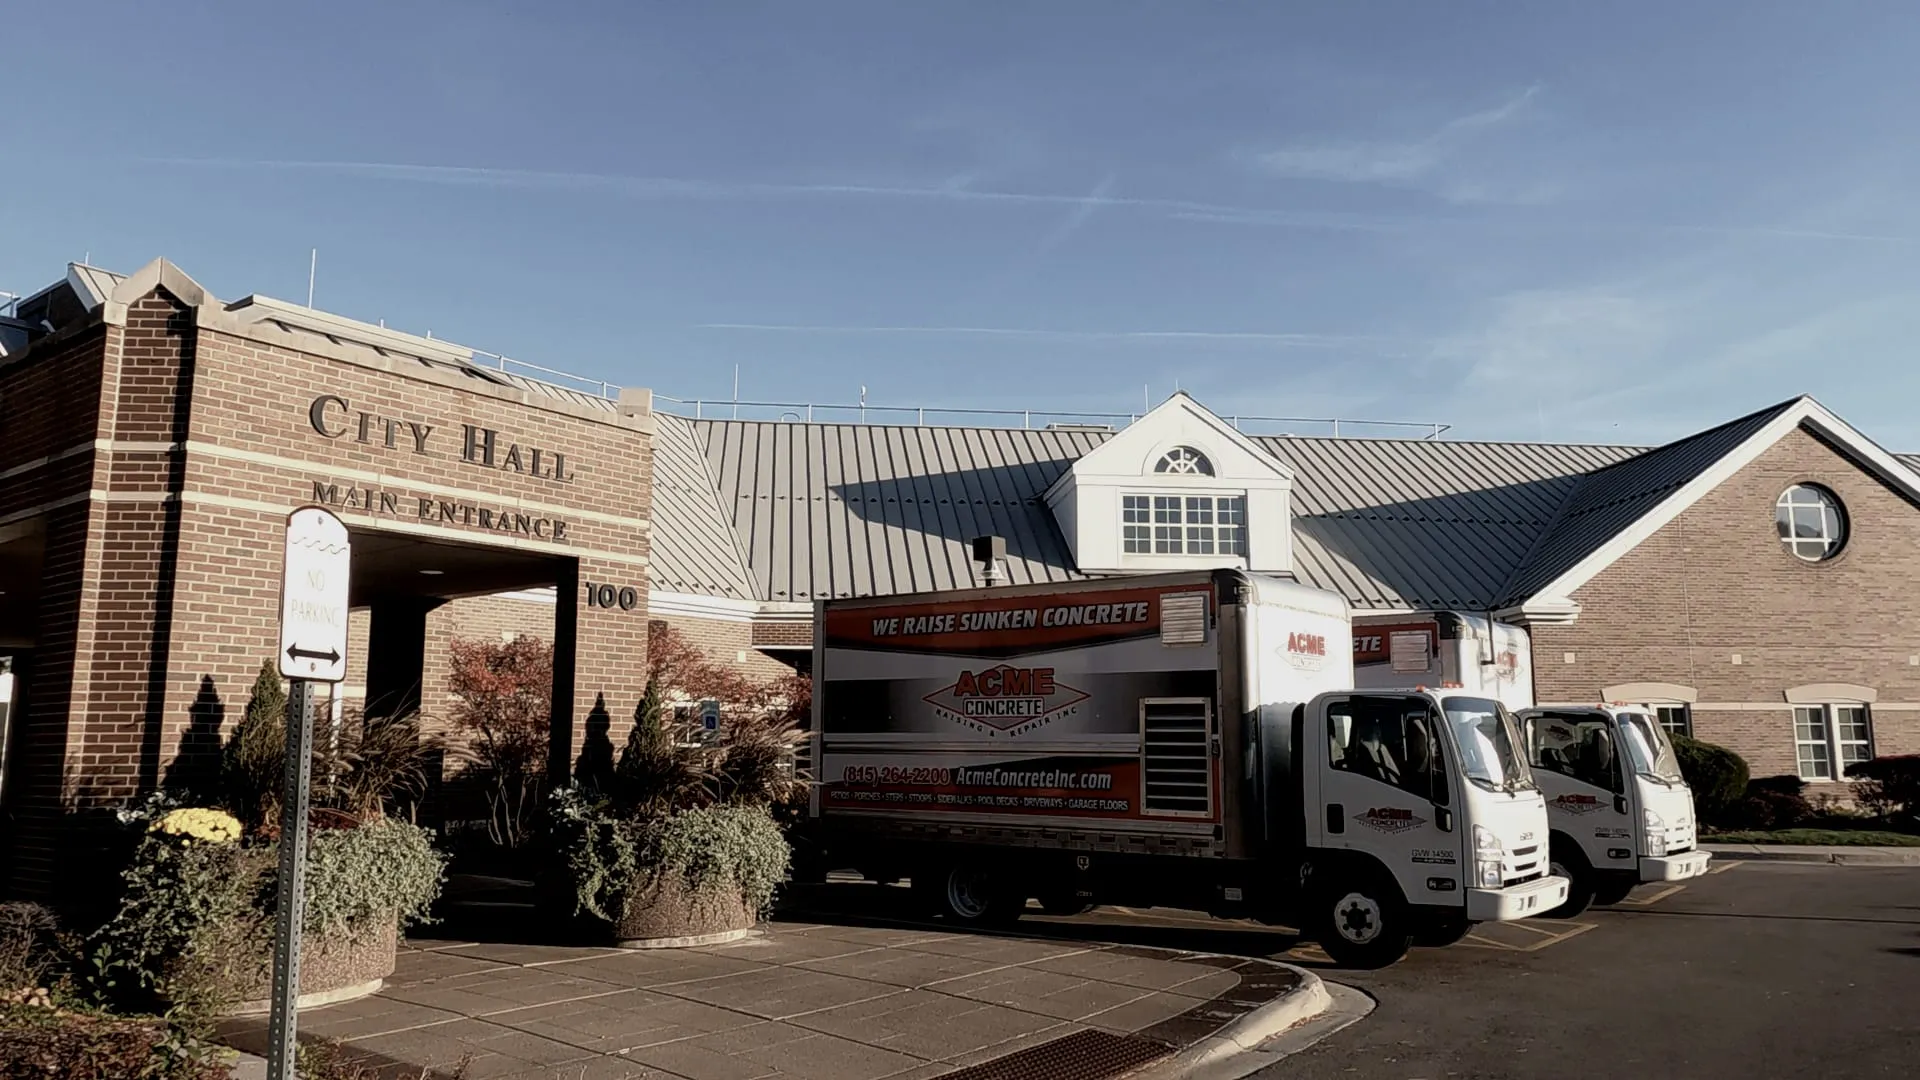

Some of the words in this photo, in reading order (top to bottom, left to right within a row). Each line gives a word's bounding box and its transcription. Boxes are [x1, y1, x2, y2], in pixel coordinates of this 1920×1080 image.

[309, 394, 435, 456] CITY
[459, 424, 575, 484] HALL
[312, 481, 398, 514] MAIN
[418, 498, 568, 541] ENTRANCE
[306, 568, 326, 592] NO
[585, 582, 638, 611] 100
[872, 618, 899, 636] WE
[903, 614, 956, 634] RAISE
[959, 608, 1037, 631] SUNKEN
[1042, 602, 1149, 627] CONCRETE
[1287, 631, 1326, 657] ACME
[953, 668, 1055, 697] ACME
[965, 699, 1042, 715] CONCRETE
[935, 708, 983, 732] RAISING
[1010, 717, 1051, 738] REPAIR
[1057, 707, 1077, 720] INC
[843, 766, 878, 787] (815)
[881, 767, 950, 785] 264-2200
[956, 767, 1112, 789] AcmeConcreteInc.com
[885, 792, 904, 802] STEPS
[908, 793, 932, 803] STOOPS
[977, 795, 995, 805] POOL
[996, 796, 1019, 807] DECKS
[1024, 796, 1063, 808] DRIVEWAYS
[1068, 799, 1098, 810] GARAGE
[1099, 800, 1128, 811] FLOORS
[1367, 807, 1412, 820] ACME
